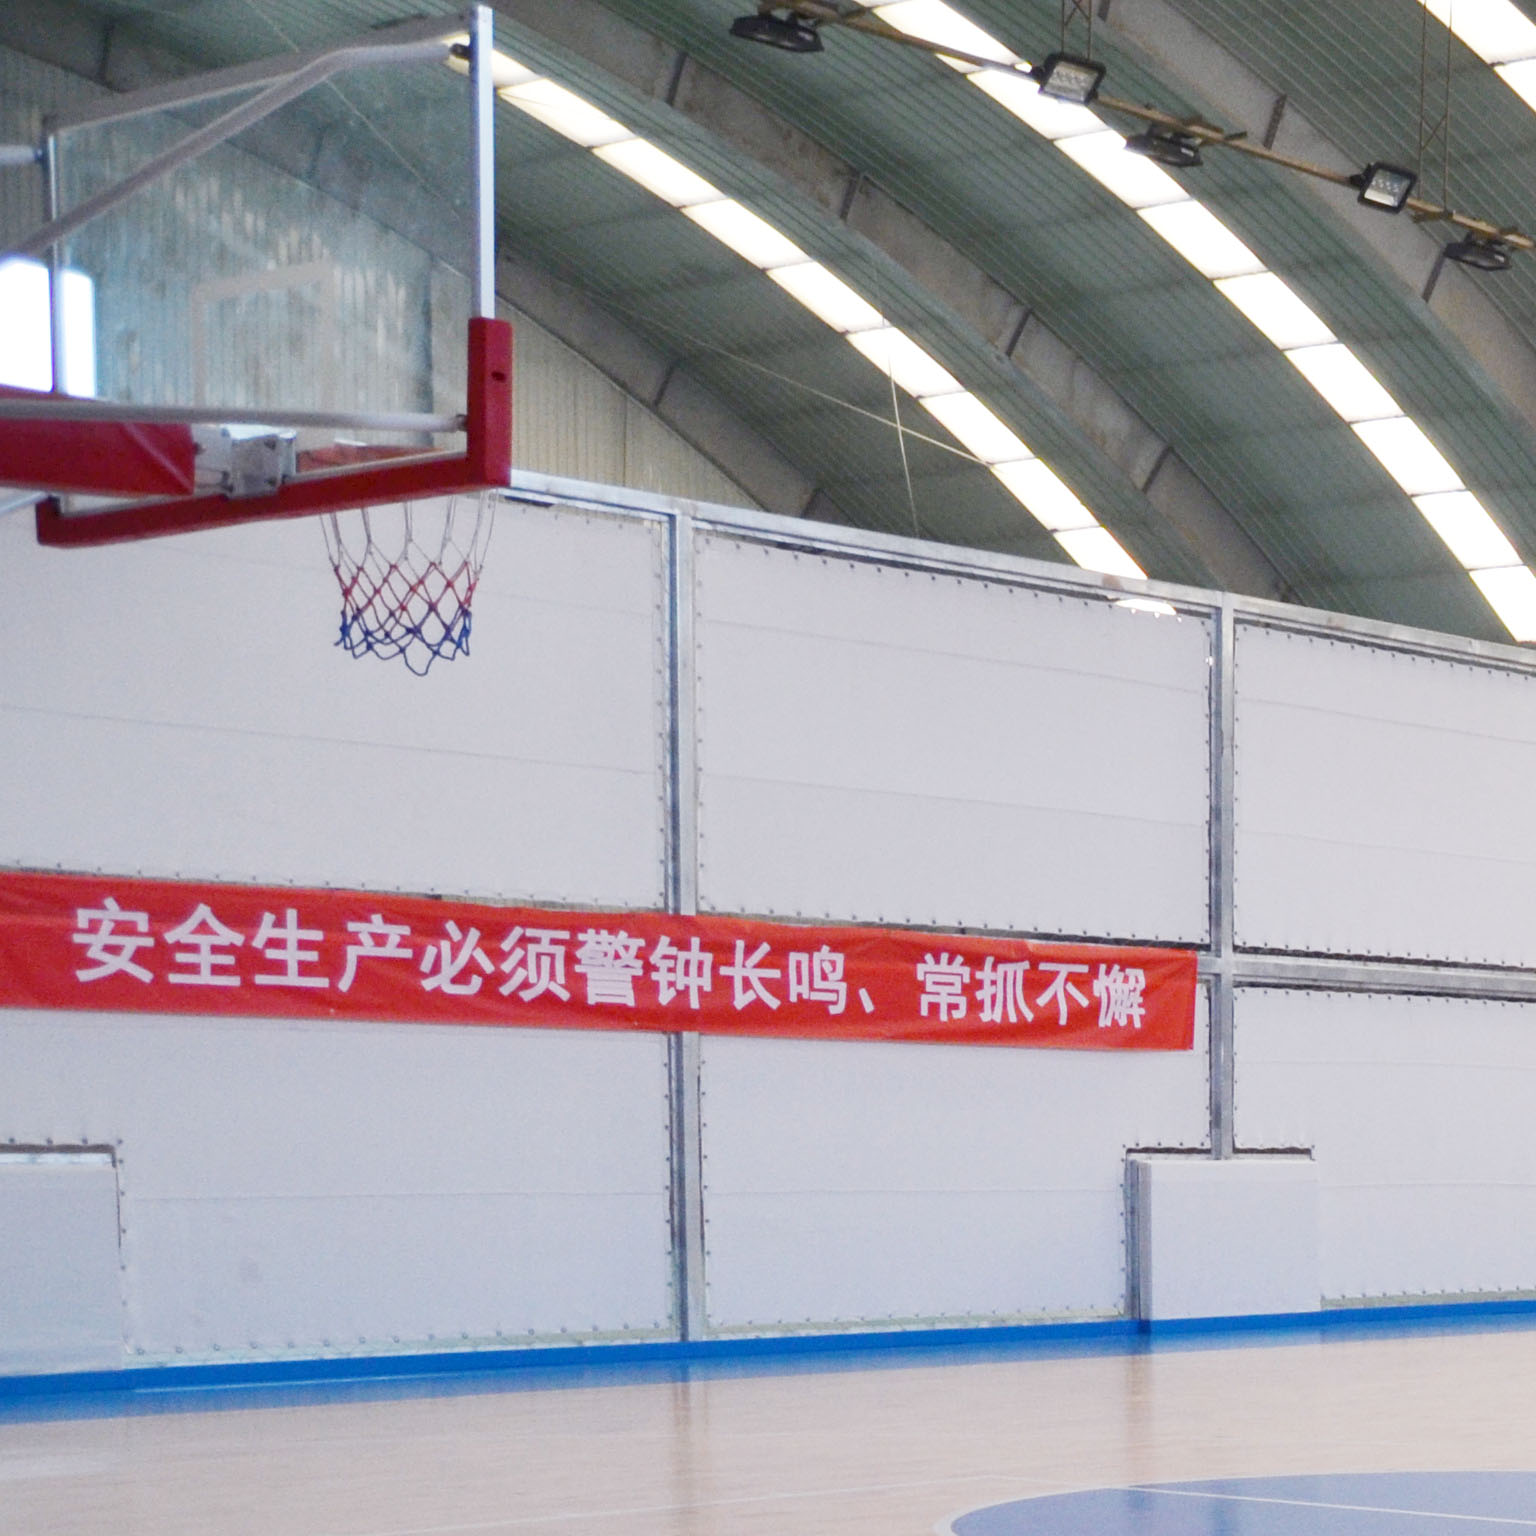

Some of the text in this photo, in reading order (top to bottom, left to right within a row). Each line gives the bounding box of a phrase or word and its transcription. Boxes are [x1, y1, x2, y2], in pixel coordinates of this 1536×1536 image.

[72, 896, 1147, 1029] 安全生产必须警钟长鸣、常抓不懈
